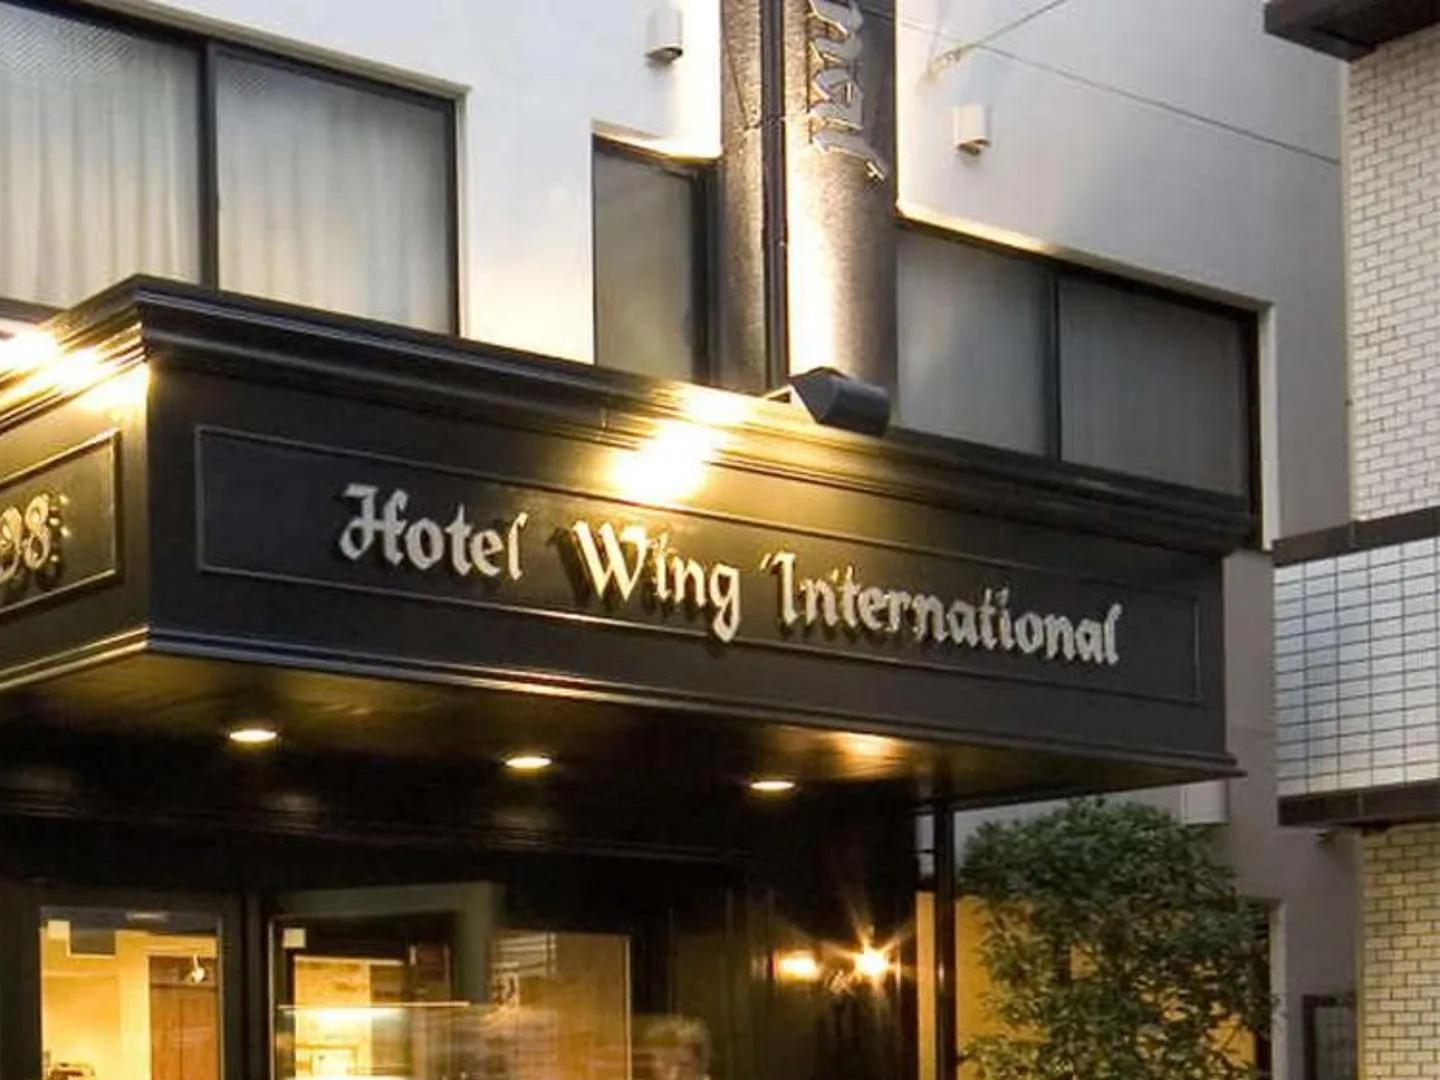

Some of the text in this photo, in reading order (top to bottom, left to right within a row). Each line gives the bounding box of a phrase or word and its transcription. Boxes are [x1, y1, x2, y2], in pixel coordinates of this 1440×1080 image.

[339, 483, 1123, 665] Hotel Wing International
